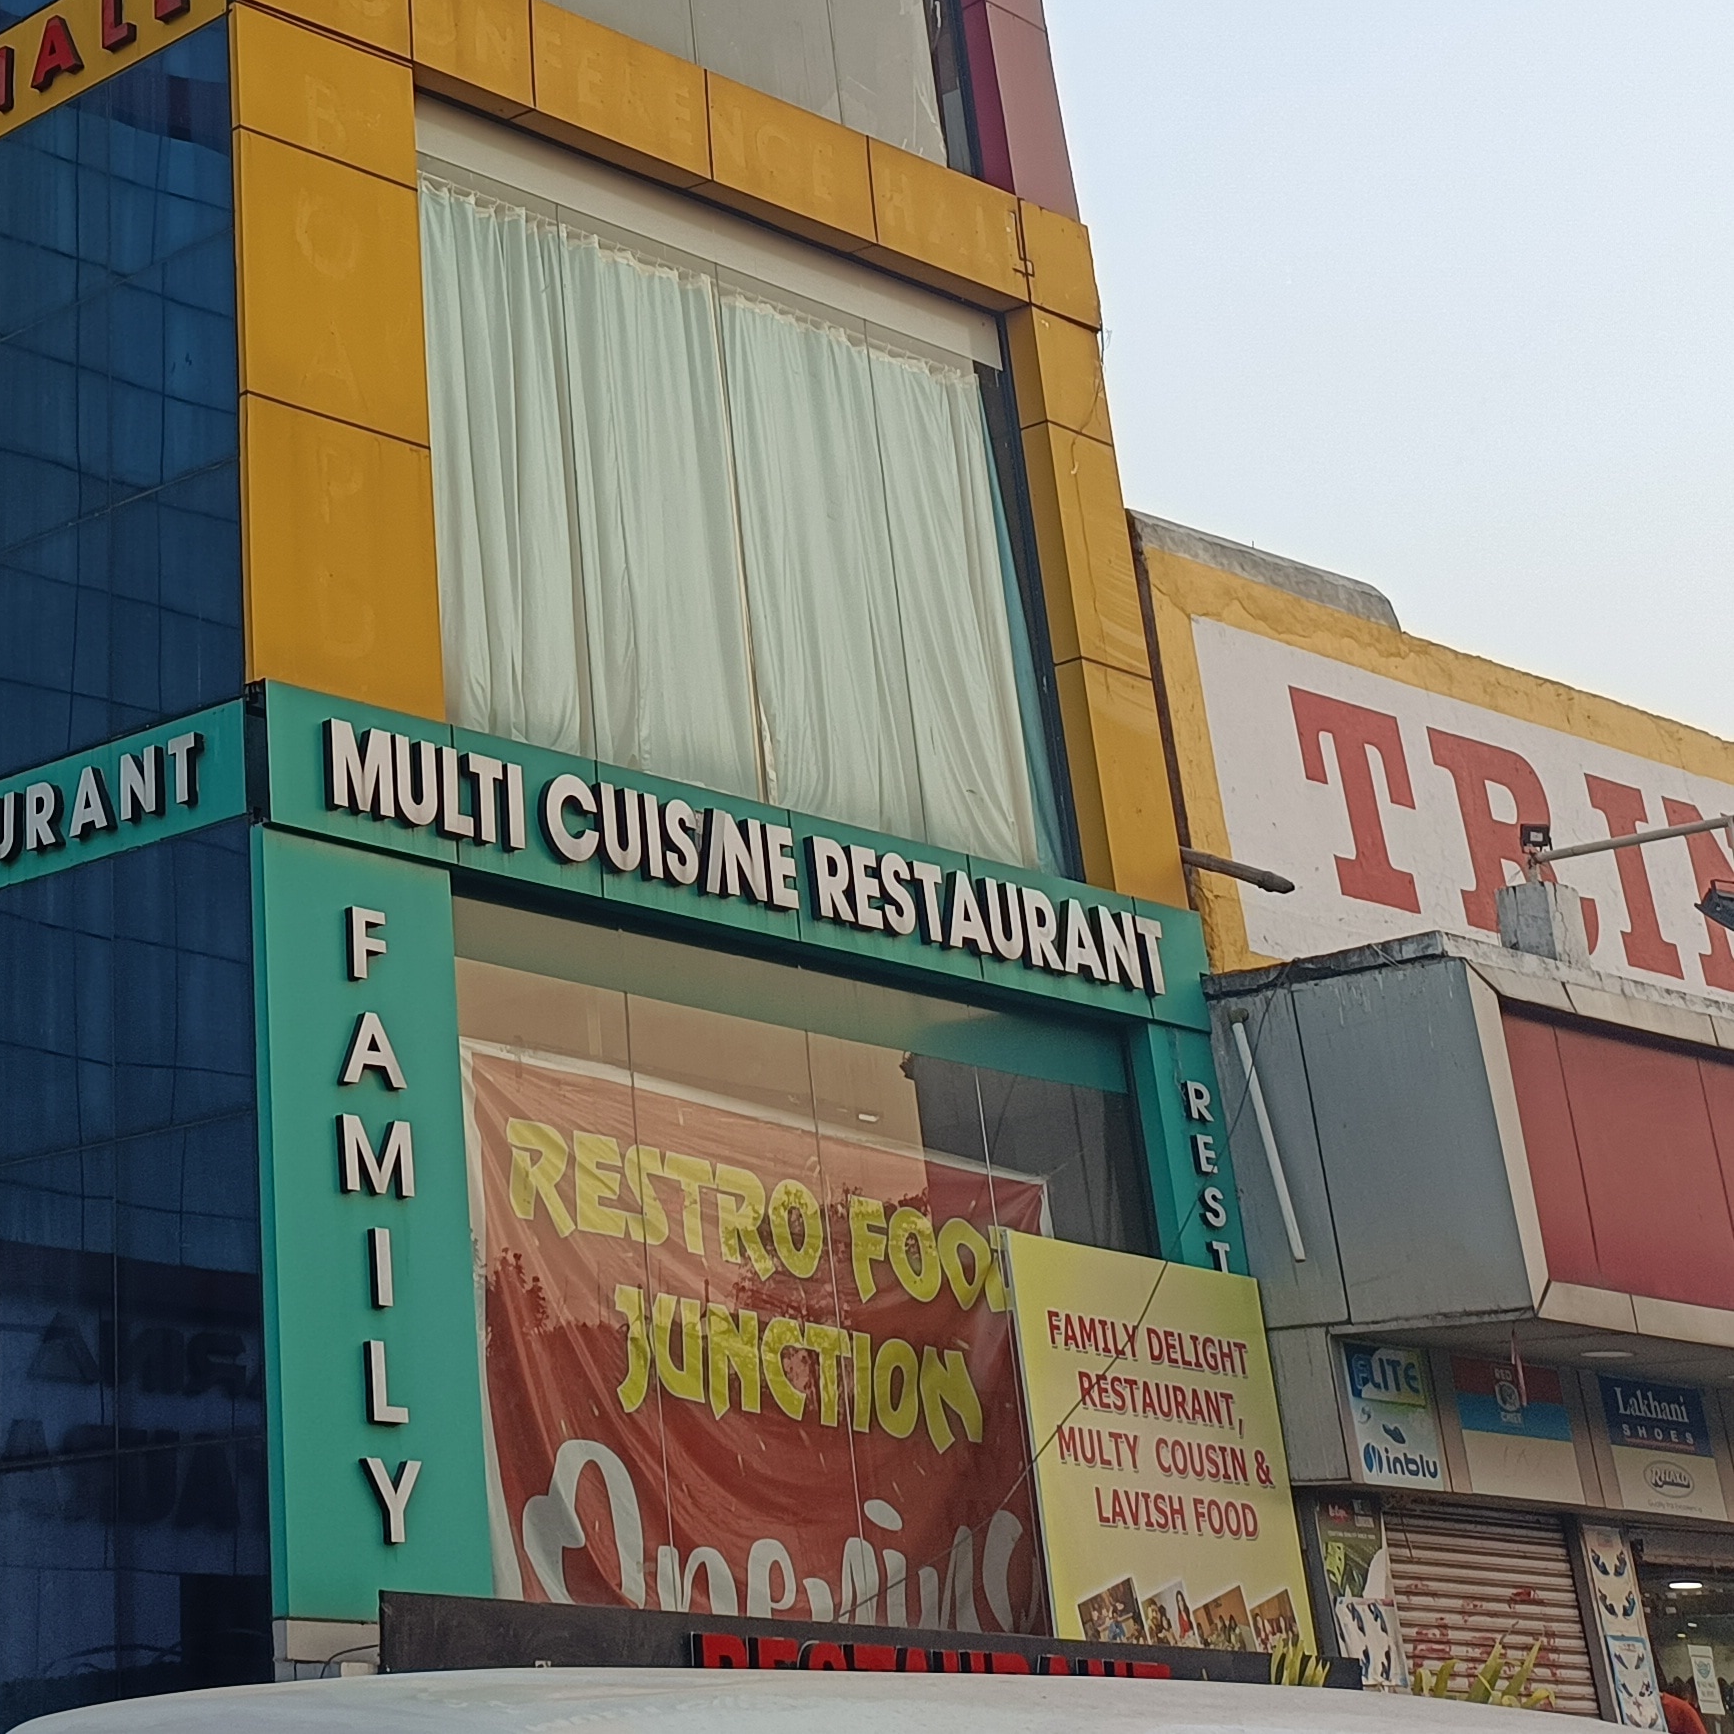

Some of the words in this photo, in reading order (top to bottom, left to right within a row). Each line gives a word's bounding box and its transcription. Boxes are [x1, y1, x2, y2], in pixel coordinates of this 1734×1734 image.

[328, 718, 524, 849] MULTI
[545, 773, 799, 911] CUISINE
[816, 838, 1164, 997] RESTAURANT
[340, 906, 421, 1544] FAMILY
[506, 1118, 823, 1281] RESTRO
[614, 1284, 983, 1454] JUNCTION
[1047, 1310, 1138, 1359] FAMILY
[1146, 1328, 1247, 1376] DELIGHT
[1078, 1371, 1243, 1436] RESTAURANT,
[1614, 1387, 1689, 1423] Lakhani
[1622, 1423, 1694, 1444] SHOES
[1057, 1425, 1139, 1469] MULTY
[1155, 1437, 1248, 1484] COUSIN
[1254, 1450, 1274, 1486] &
[1384, 1447, 1438, 1478] inblu
[1095, 1487, 1186, 1531] LAVISH
[1193, 1498, 1258, 1538] FOOD
